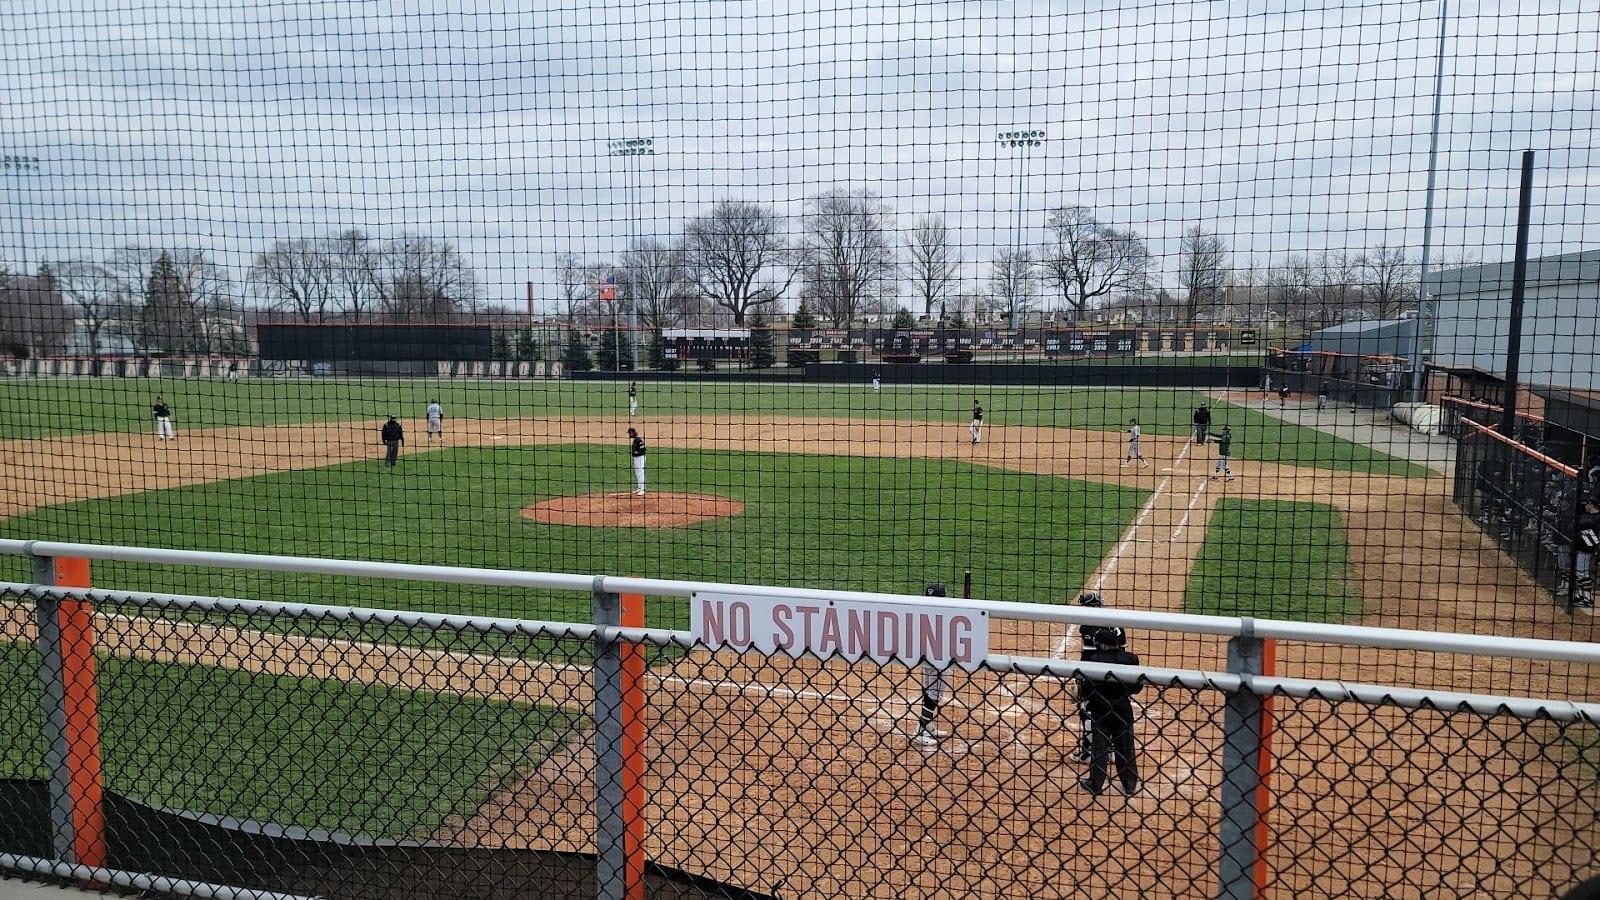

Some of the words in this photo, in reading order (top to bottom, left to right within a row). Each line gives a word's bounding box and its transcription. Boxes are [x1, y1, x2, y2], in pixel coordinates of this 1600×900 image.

[437, 360, 564, 377] WARRIORS
[701, 599, 751, 647] NO
[772, 603, 972, 664] STANDING
